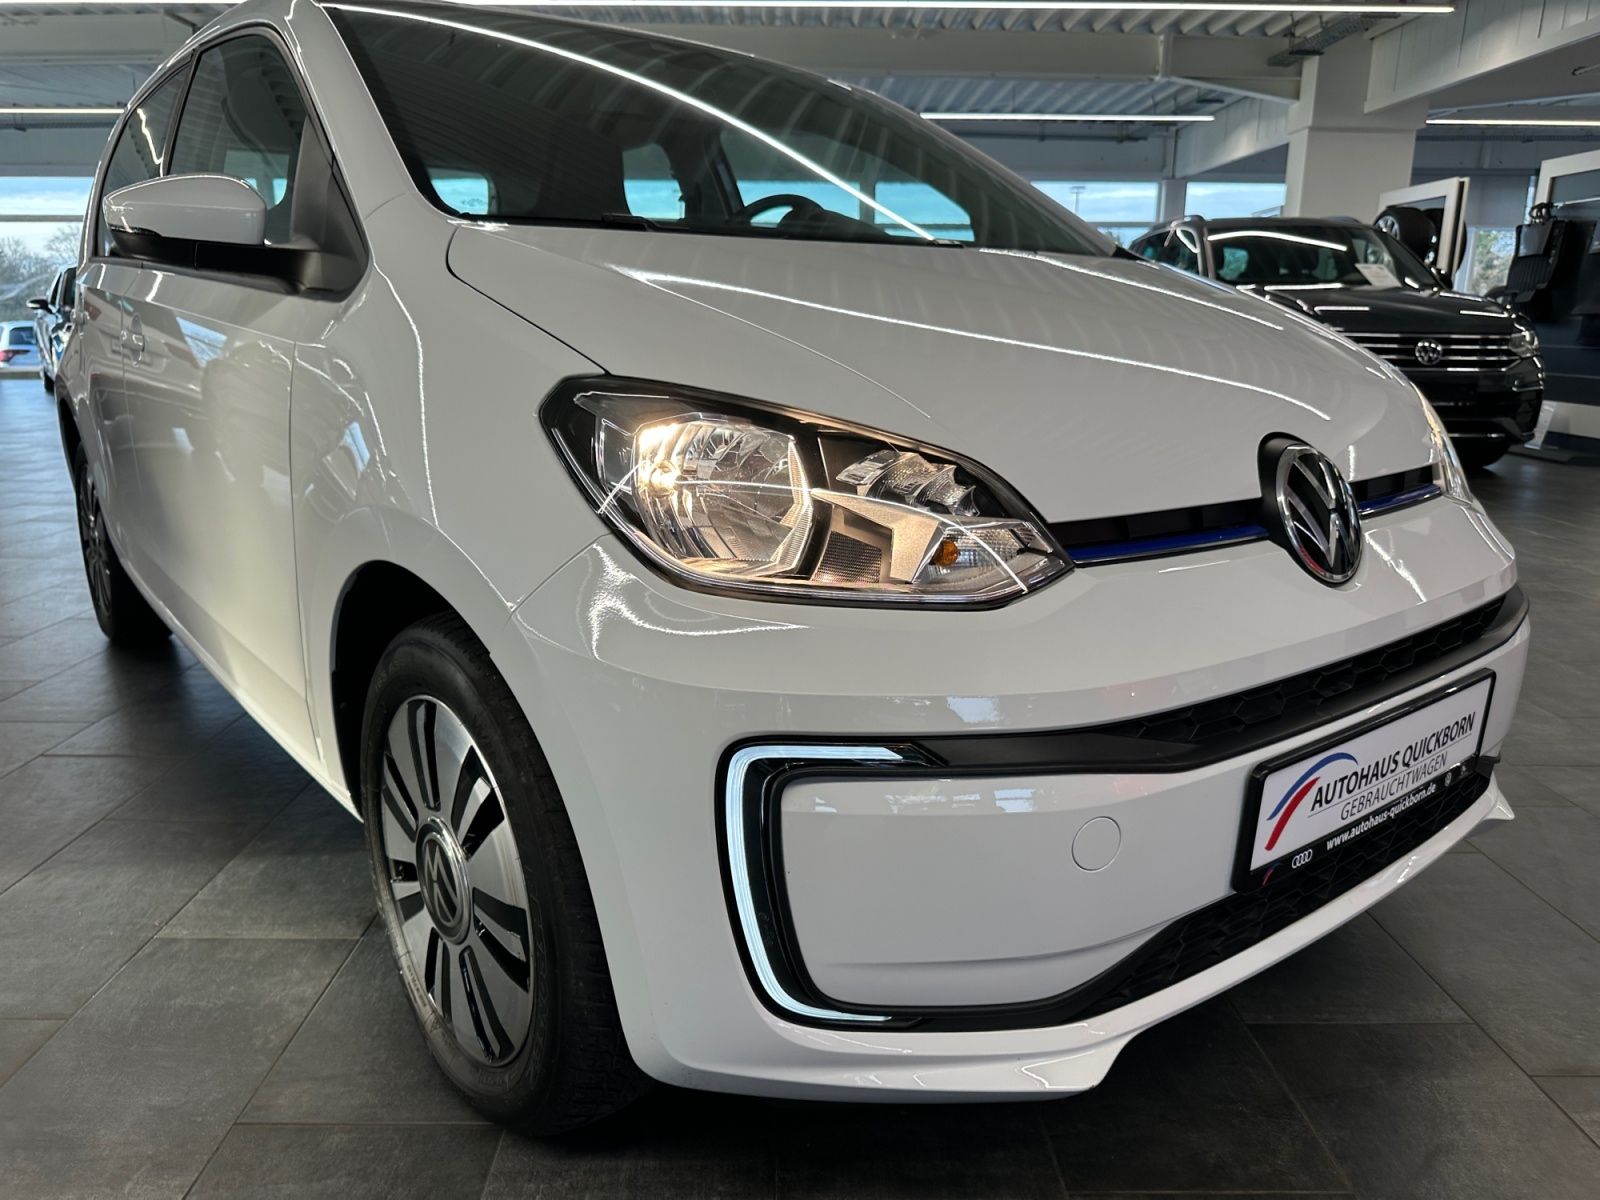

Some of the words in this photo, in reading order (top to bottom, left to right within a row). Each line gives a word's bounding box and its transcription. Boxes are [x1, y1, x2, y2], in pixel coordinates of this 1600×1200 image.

[1311, 755, 1400, 811] AUTOHAUS
[1402, 712, 1475, 767] QUICKBORN
[1341, 752, 1447, 821] GEBRAUCHTWAGEN
[1326, 783, 1436, 850] www.autohaus-quickborn.de
